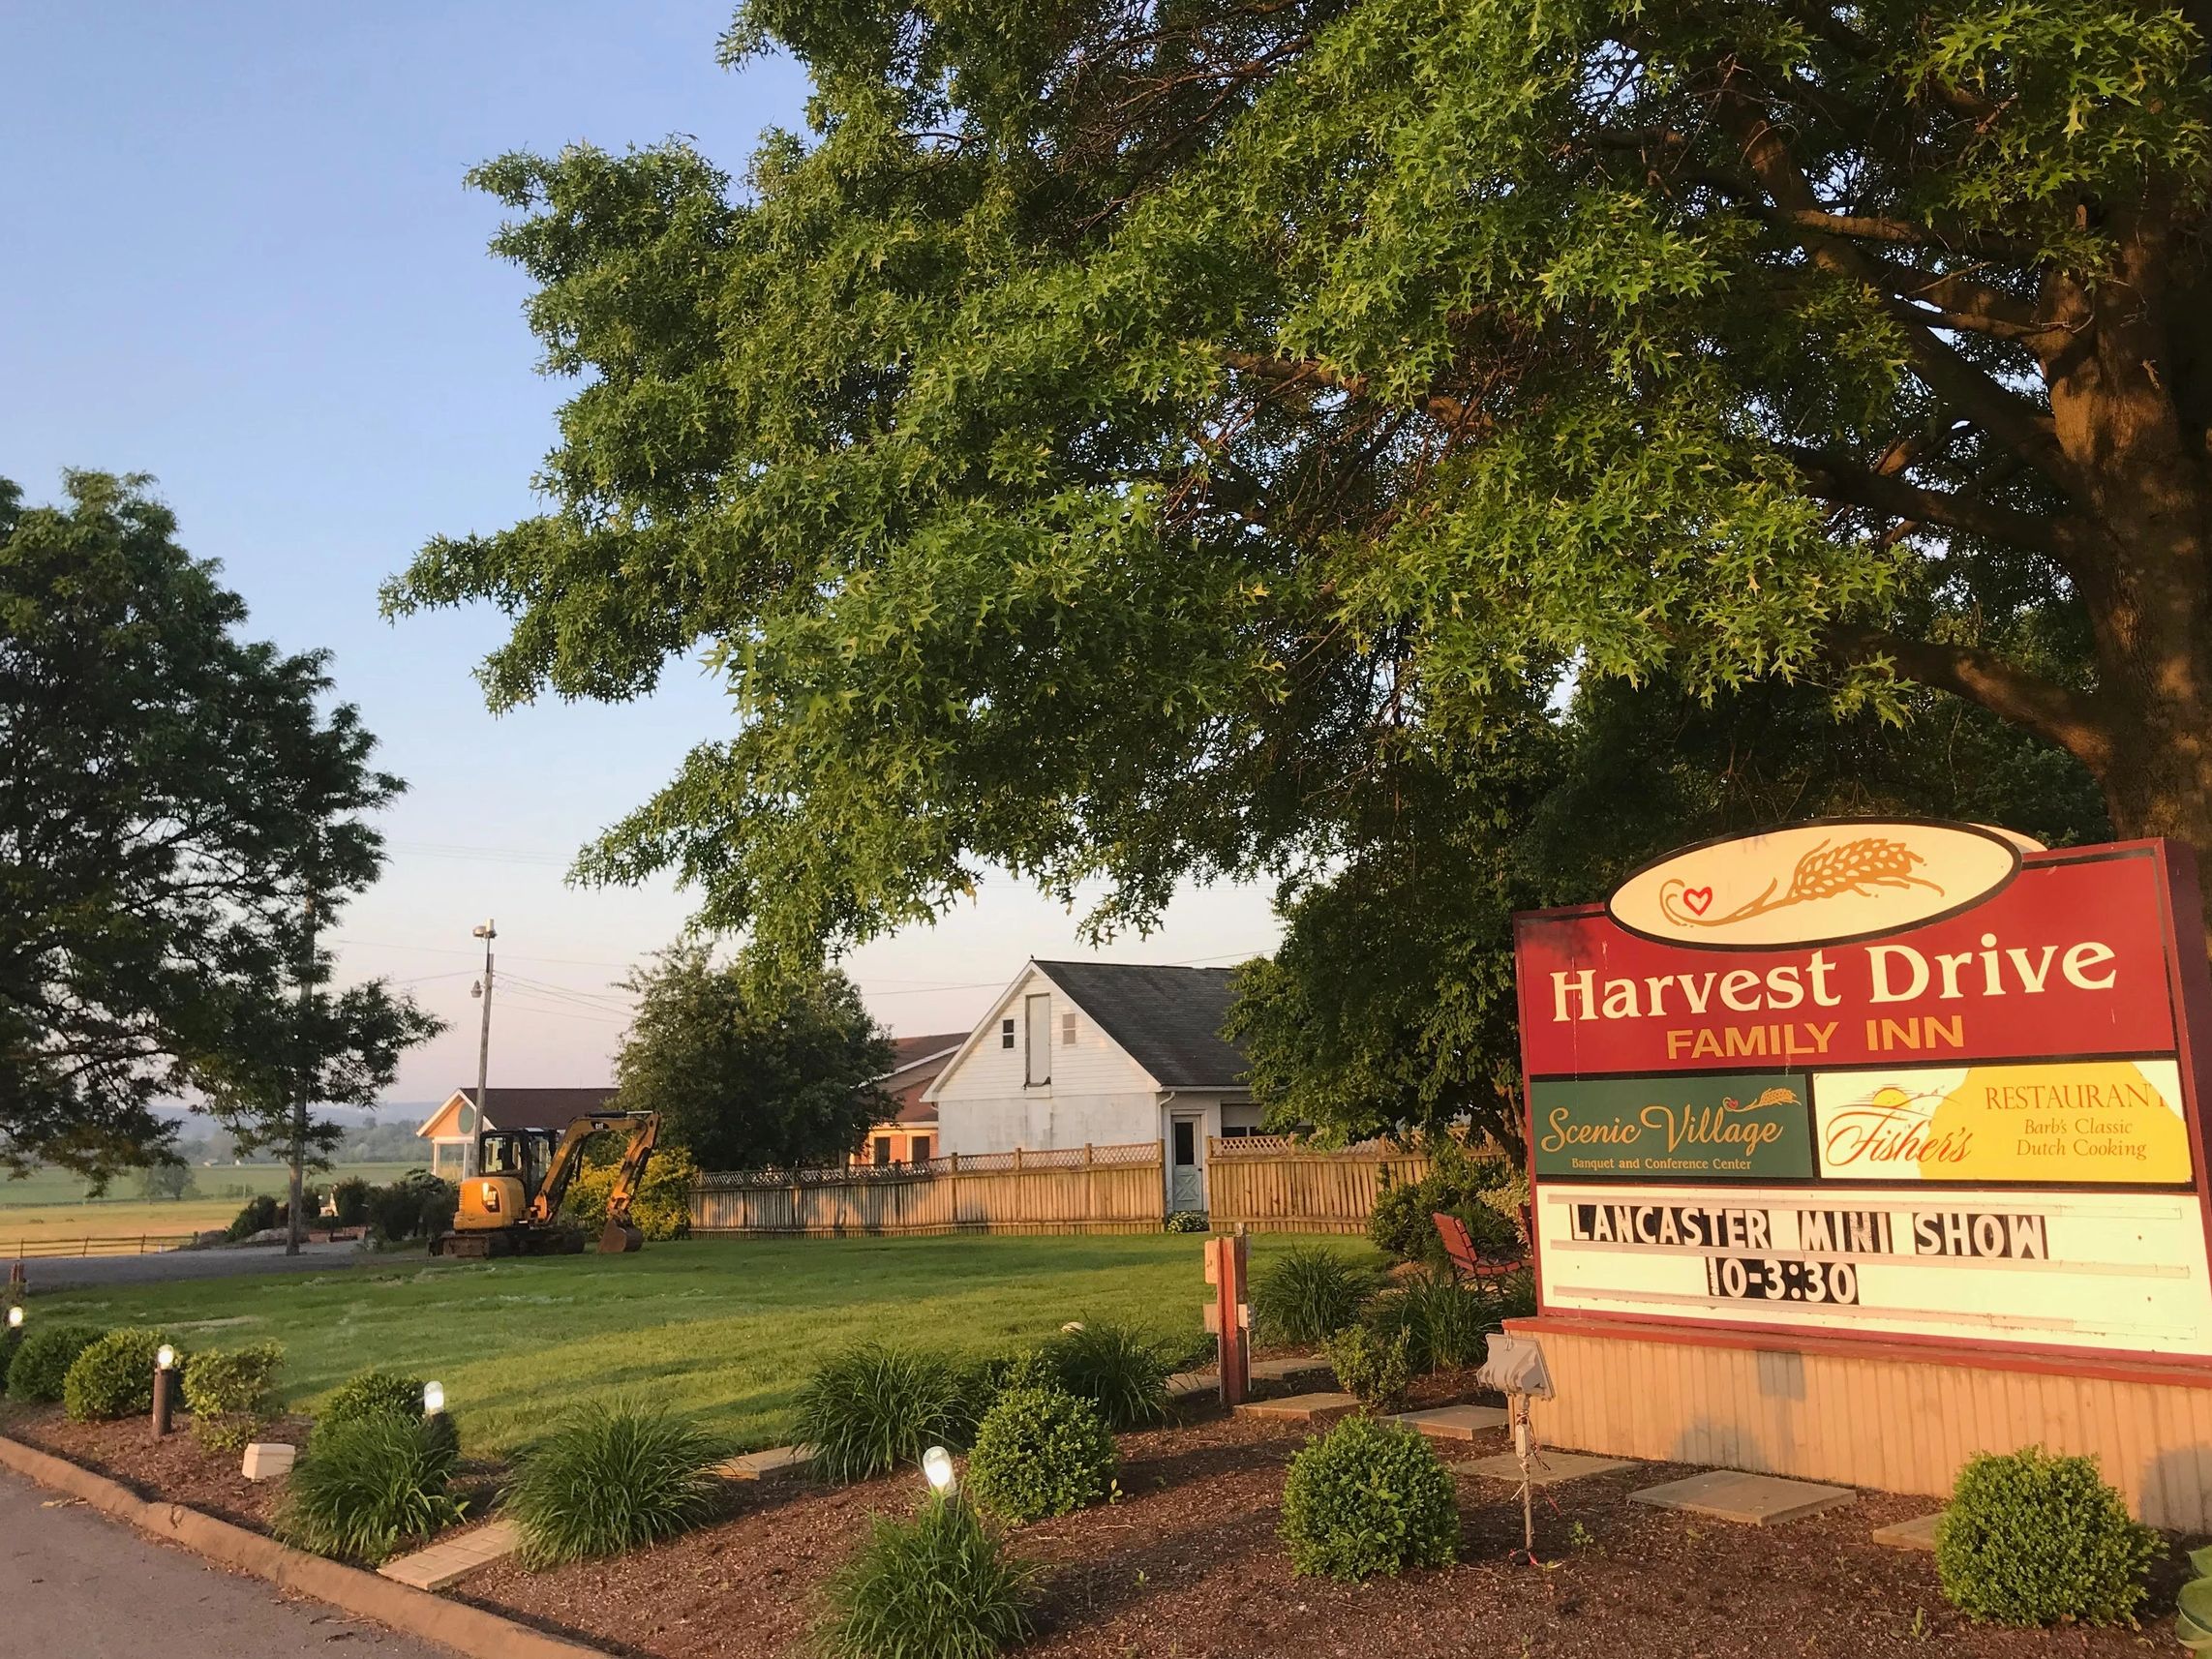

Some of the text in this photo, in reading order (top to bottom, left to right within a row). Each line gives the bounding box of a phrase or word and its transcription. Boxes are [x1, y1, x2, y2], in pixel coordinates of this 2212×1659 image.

[1550, 932, 2117, 1022] Harvest Drive
[1666, 1014, 1964, 1060] FAMILY INN
[1540, 1104, 1783, 1157] Scenic Village
[1826, 1111, 1974, 1167] Fisher's
[2016, 1138, 2148, 1161] Dutch Cooking
[2024, 1118, 2134, 1135] Barb's Classic
[1571, 1158, 1752, 1171] Banquet and Conference Center
[1572, 1204, 2045, 1258] LANCASTER MINI SHOW
[1709, 1258, 1857, 1304] 10-3:30
